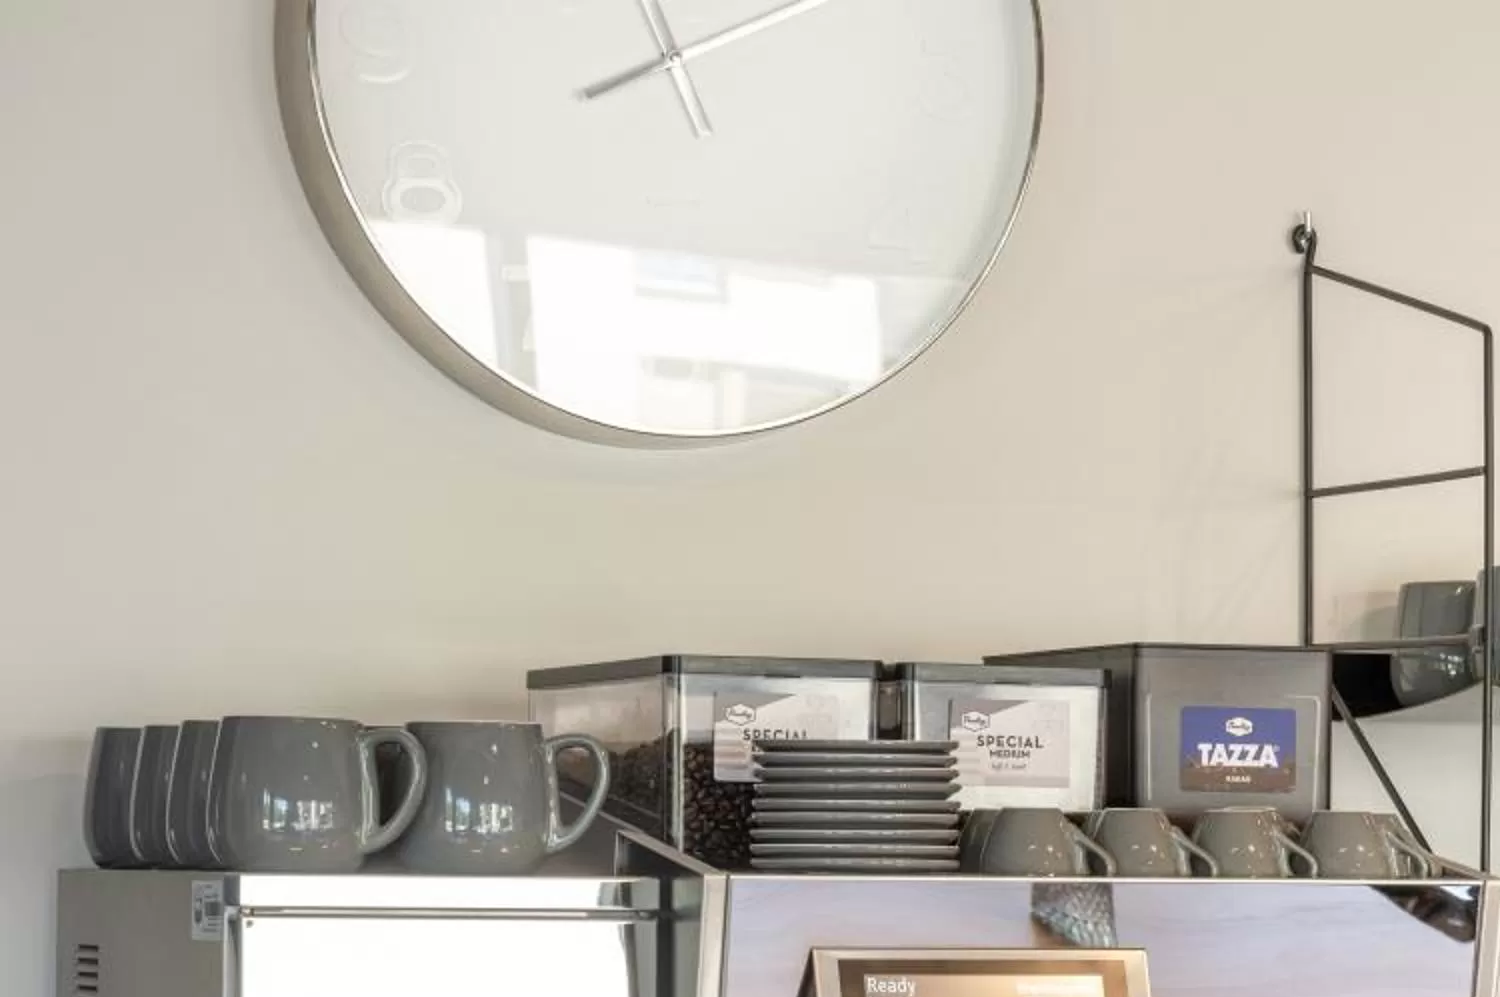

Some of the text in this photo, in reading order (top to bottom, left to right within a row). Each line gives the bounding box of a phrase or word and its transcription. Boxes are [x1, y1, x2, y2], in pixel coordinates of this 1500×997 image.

[976, 735, 1045, 749] SPECIAL
[989, 749, 1031, 759] MEDIUM
[1196, 742, 1280, 768] TAZZA
[867, 976, 916, 997] Ready
